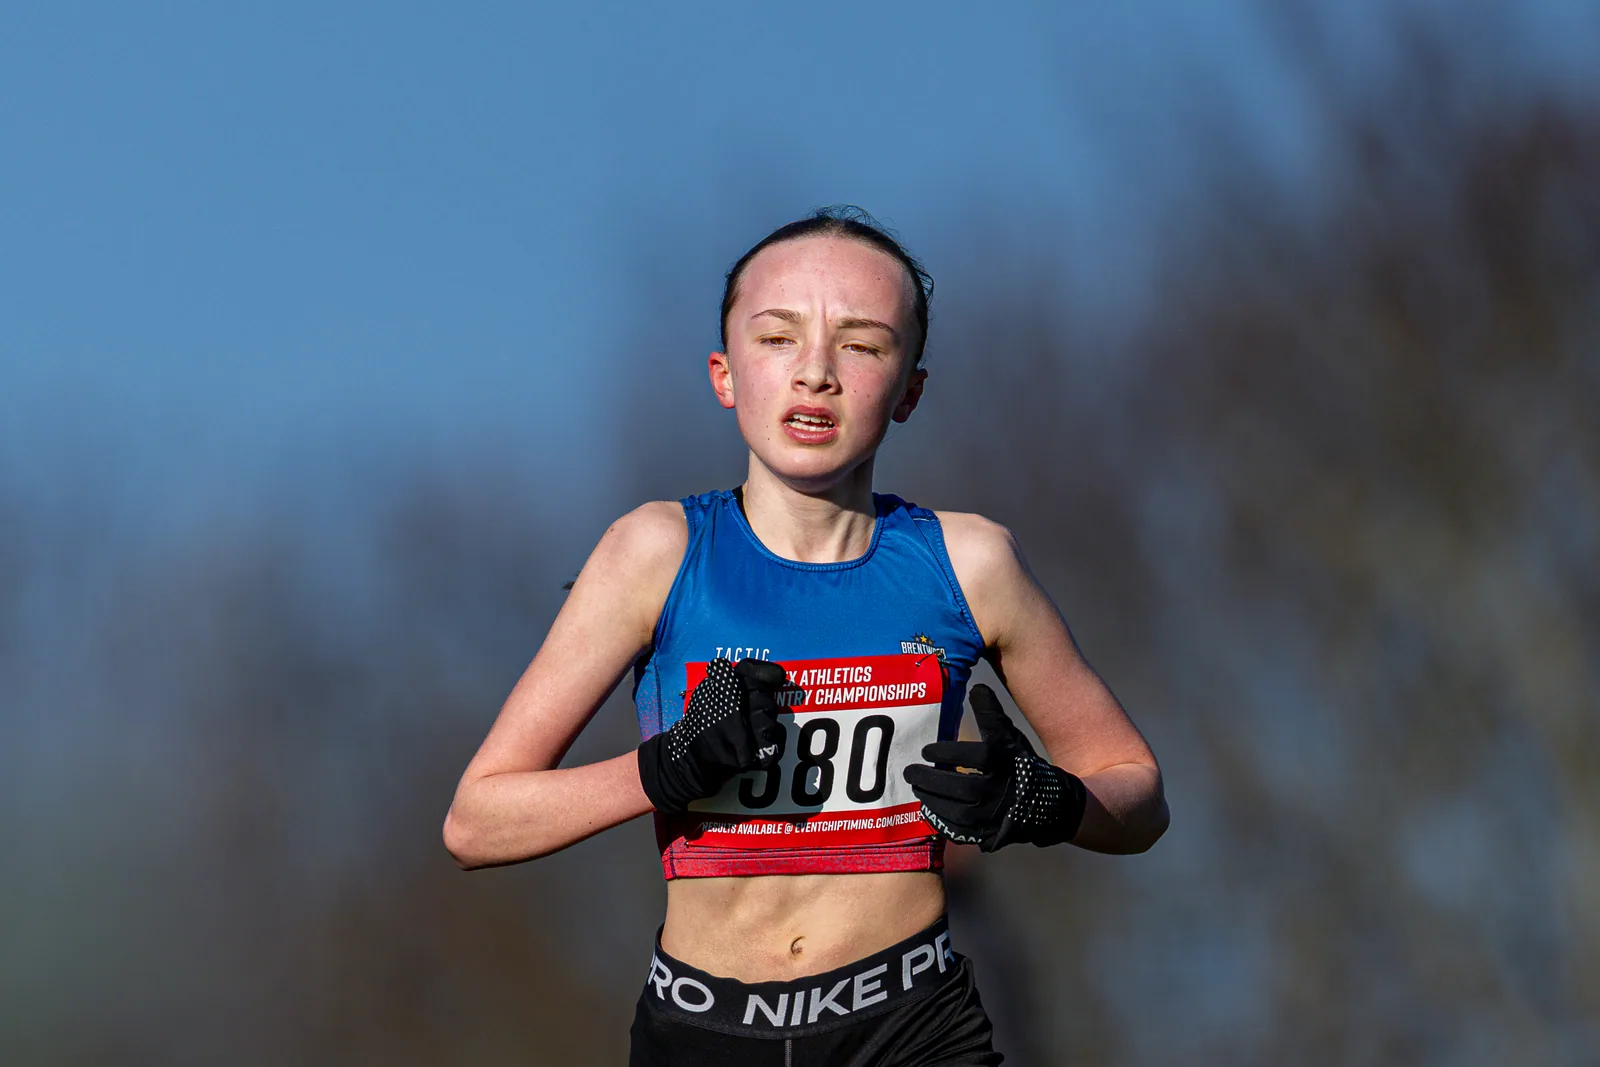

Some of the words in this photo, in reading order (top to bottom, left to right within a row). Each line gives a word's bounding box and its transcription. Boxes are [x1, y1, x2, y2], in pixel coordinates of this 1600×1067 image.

[715, 647, 770, 663] TACTIC
[900, 641, 947, 660] BRENTWD
[799, 666, 872, 687] ATHLETICS
[774, 689, 813, 707] NTRY
[815, 682, 926, 706] CHAMPIONSHIPS
[702, 821, 737, 834] RESULTS
[737, 823, 783, 835] AVAILABLE
[784, 822, 794, 835] @
[647, 949, 715, 1013] RO
[742, 962, 888, 1027] NIKE
[902, 929, 955, 991] PR
